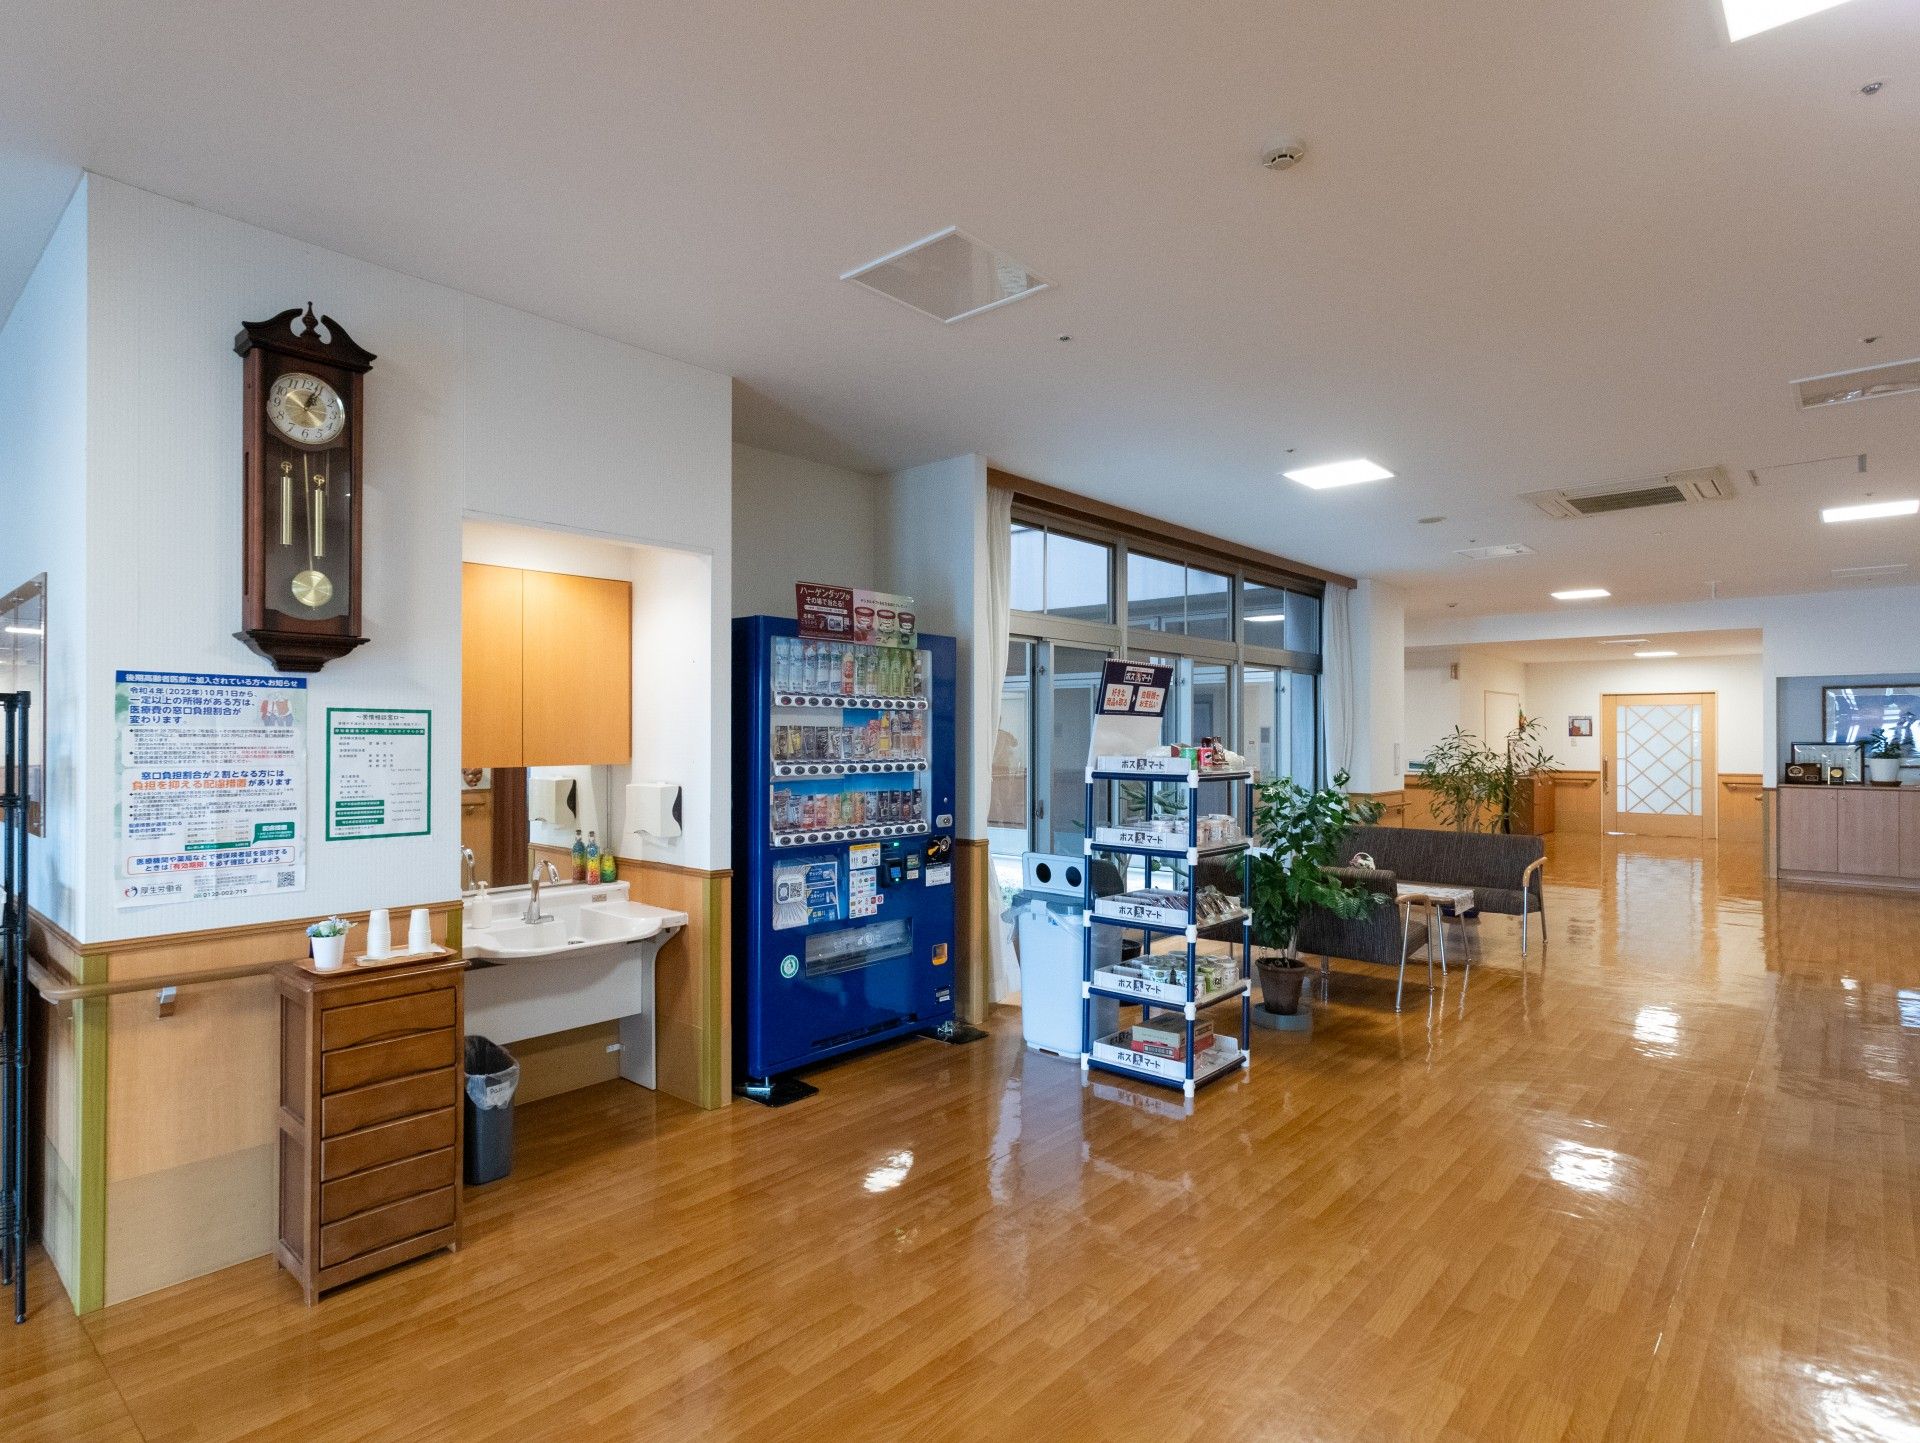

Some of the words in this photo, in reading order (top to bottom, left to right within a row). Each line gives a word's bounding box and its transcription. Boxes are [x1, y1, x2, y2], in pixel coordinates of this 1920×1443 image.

[302, 380, 314, 390] 12
[276, 385, 288, 396] 10
[274, 397, 281, 407] 9
[327, 398, 335, 408] 2
[276, 411, 285, 420] 8
[329, 411, 337, 420] 3
[286, 422, 296, 432] 7
[325, 422, 333, 431] 4
[301, 429, 310, 438] 6
[315, 429, 323, 438] 5
[129, 706, 242, 716] 医療費の窓口負担割合が
[140, 885, 182, 896] 厚生労働省
